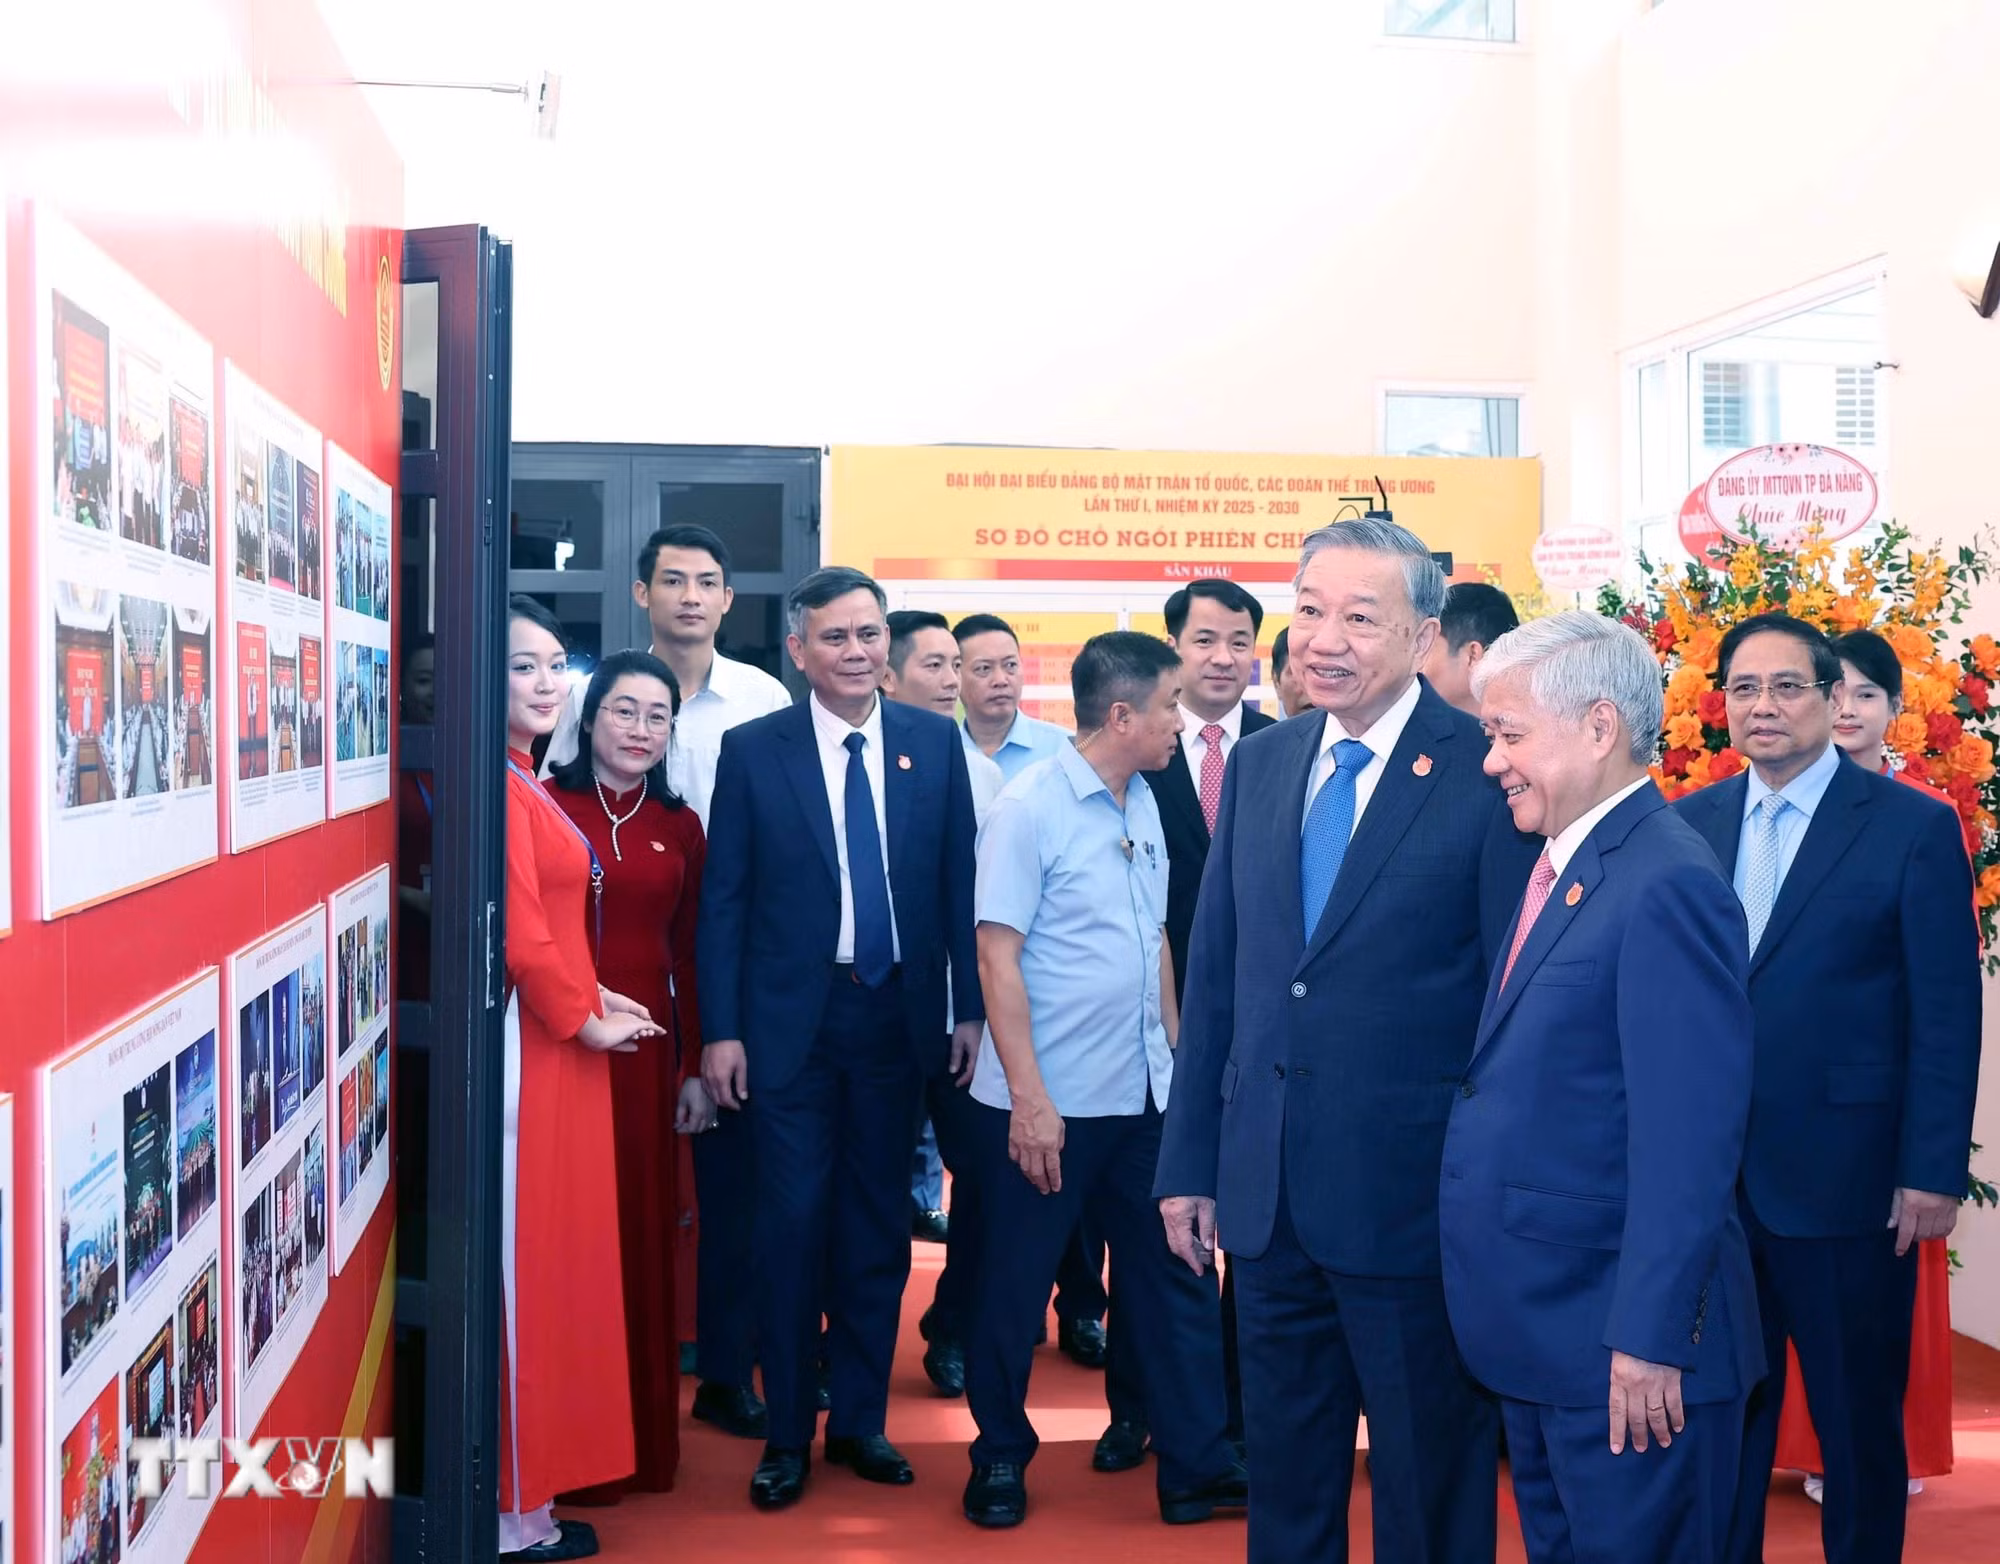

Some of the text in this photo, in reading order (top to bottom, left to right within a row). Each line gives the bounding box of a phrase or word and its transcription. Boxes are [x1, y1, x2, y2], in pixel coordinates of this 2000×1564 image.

[946, 469, 1435, 493] ĐẠI HỘI ĐẠI BIỂU ĐẢNG BỘ MẶT TRẬN TỔ QUỐC, CÁC ĐOÀN THỂ TRUNG ƯƠNG
[1718, 465, 1863, 496] ĐẢNG ỦY MTTQVN TP ĐÀ NẴNG
[1084, 494, 1110, 512] LẦN
[1115, 496, 1138, 512] THỨ
[1155, 497, 1198, 516] NHIỆM
[1203, 496, 1219, 513] KỲ
[1223, 500, 1255, 514] 2025
[1268, 500, 1300, 515] 2030
[1015, 524, 1049, 546] ĐỒ
[1058, 523, 1108, 547] CHỖ
[1117, 525, 1178, 548] NGỒI
[1185, 527, 1256, 548] PHIÊN
[1264, 527, 1305, 549] CHÍ
